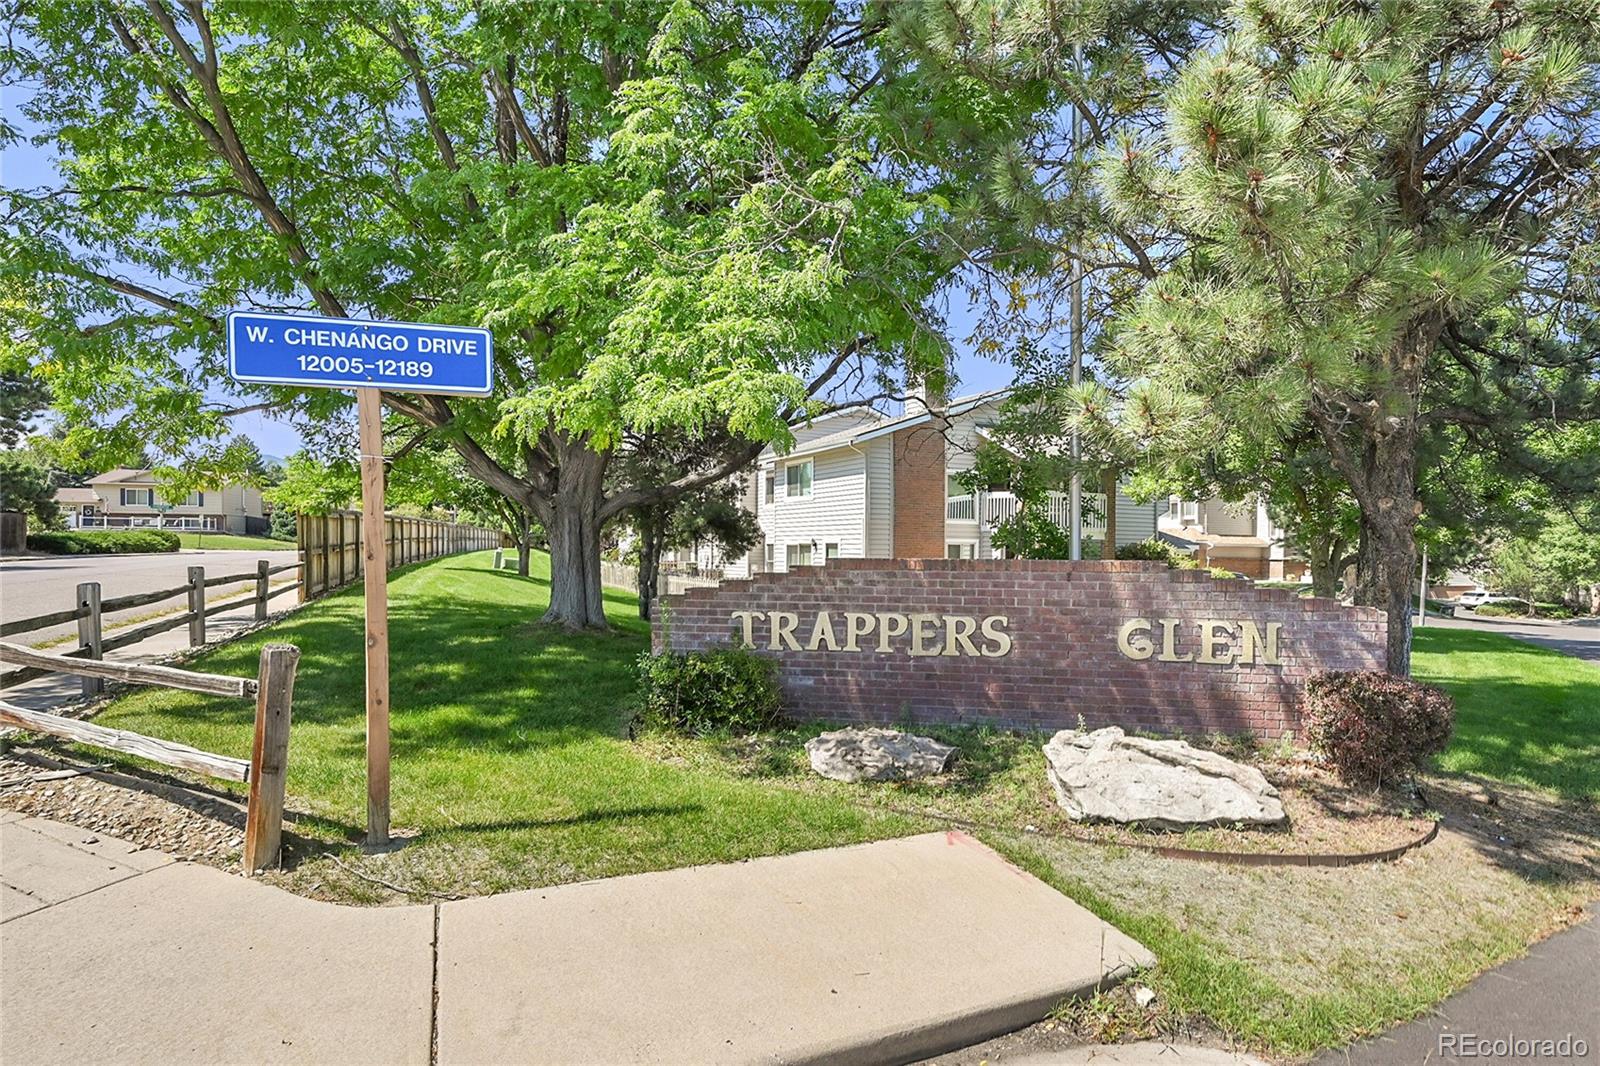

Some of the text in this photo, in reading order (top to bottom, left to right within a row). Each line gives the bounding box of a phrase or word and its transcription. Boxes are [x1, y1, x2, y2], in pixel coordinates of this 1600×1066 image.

[246, 326, 478, 356] W. CHENANGO DRIVE
[297, 355, 433, 378] 12005-12189
[731, 610, 1283, 666] TRAPPERS GLEN
